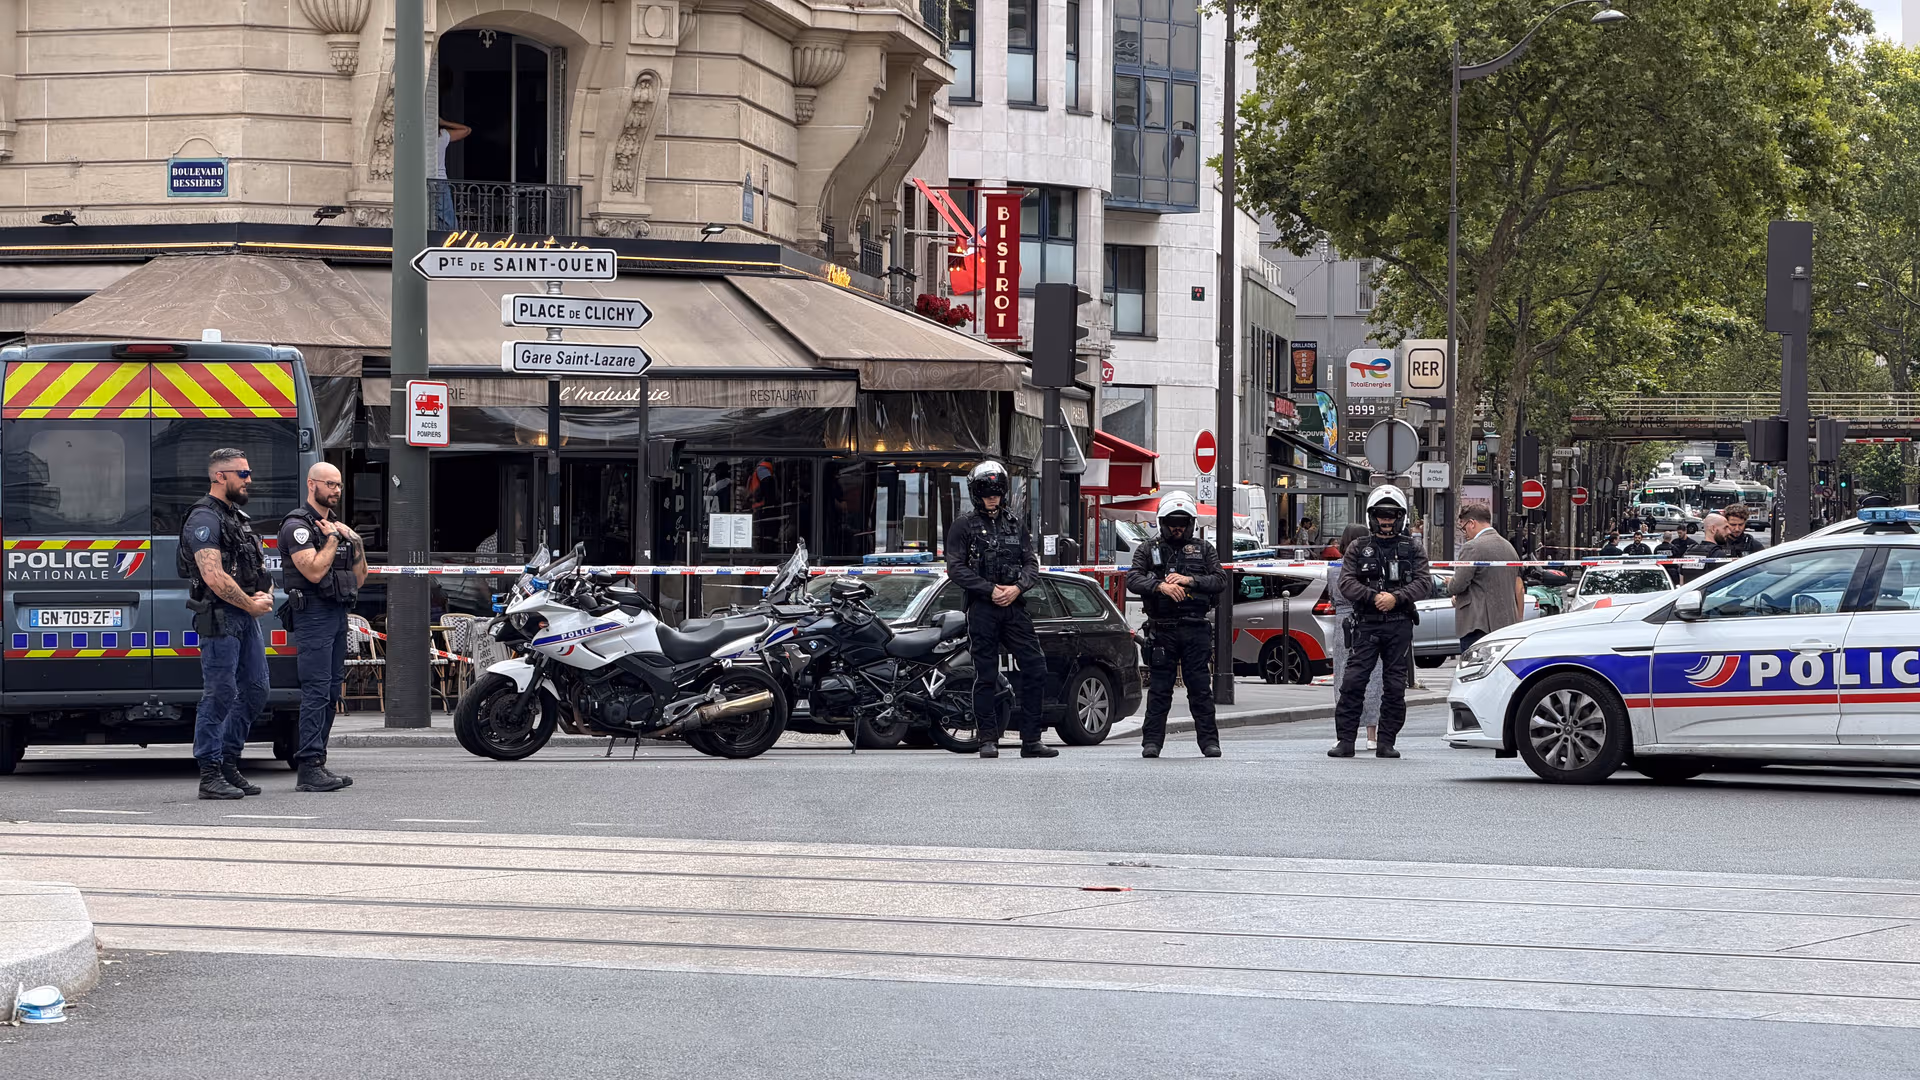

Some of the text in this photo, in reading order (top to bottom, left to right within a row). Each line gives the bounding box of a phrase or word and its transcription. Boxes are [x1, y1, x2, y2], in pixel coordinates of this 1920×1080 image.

[172, 167, 224, 176] BOULEVARD
[173, 176, 222, 187] BESSIÈRES
[470, 261, 485, 272] DE
[493, 257, 608, 272] SAINT-OUEN
[994, 206, 1010, 328] BISTROT
[519, 303, 635, 321] PLACE DE CLICHY
[521, 349, 636, 367] Gare Saint-Lazare
[1412, 361, 1439, 376] RER
[559, 386, 671, 402] l'Industie
[749, 389, 818, 402] RESTAURANT
[421, 421, 438, 429] ACCÈS
[416, 430, 442, 438] POMPIERS
[8, 552, 109, 568] POLICE
[8, 571, 109, 580] NATIONALE
[41, 611, 121, 625] GN-709-ZF 75
[560, 626, 596, 641] POLICE
[748, 644, 760, 653] 17
